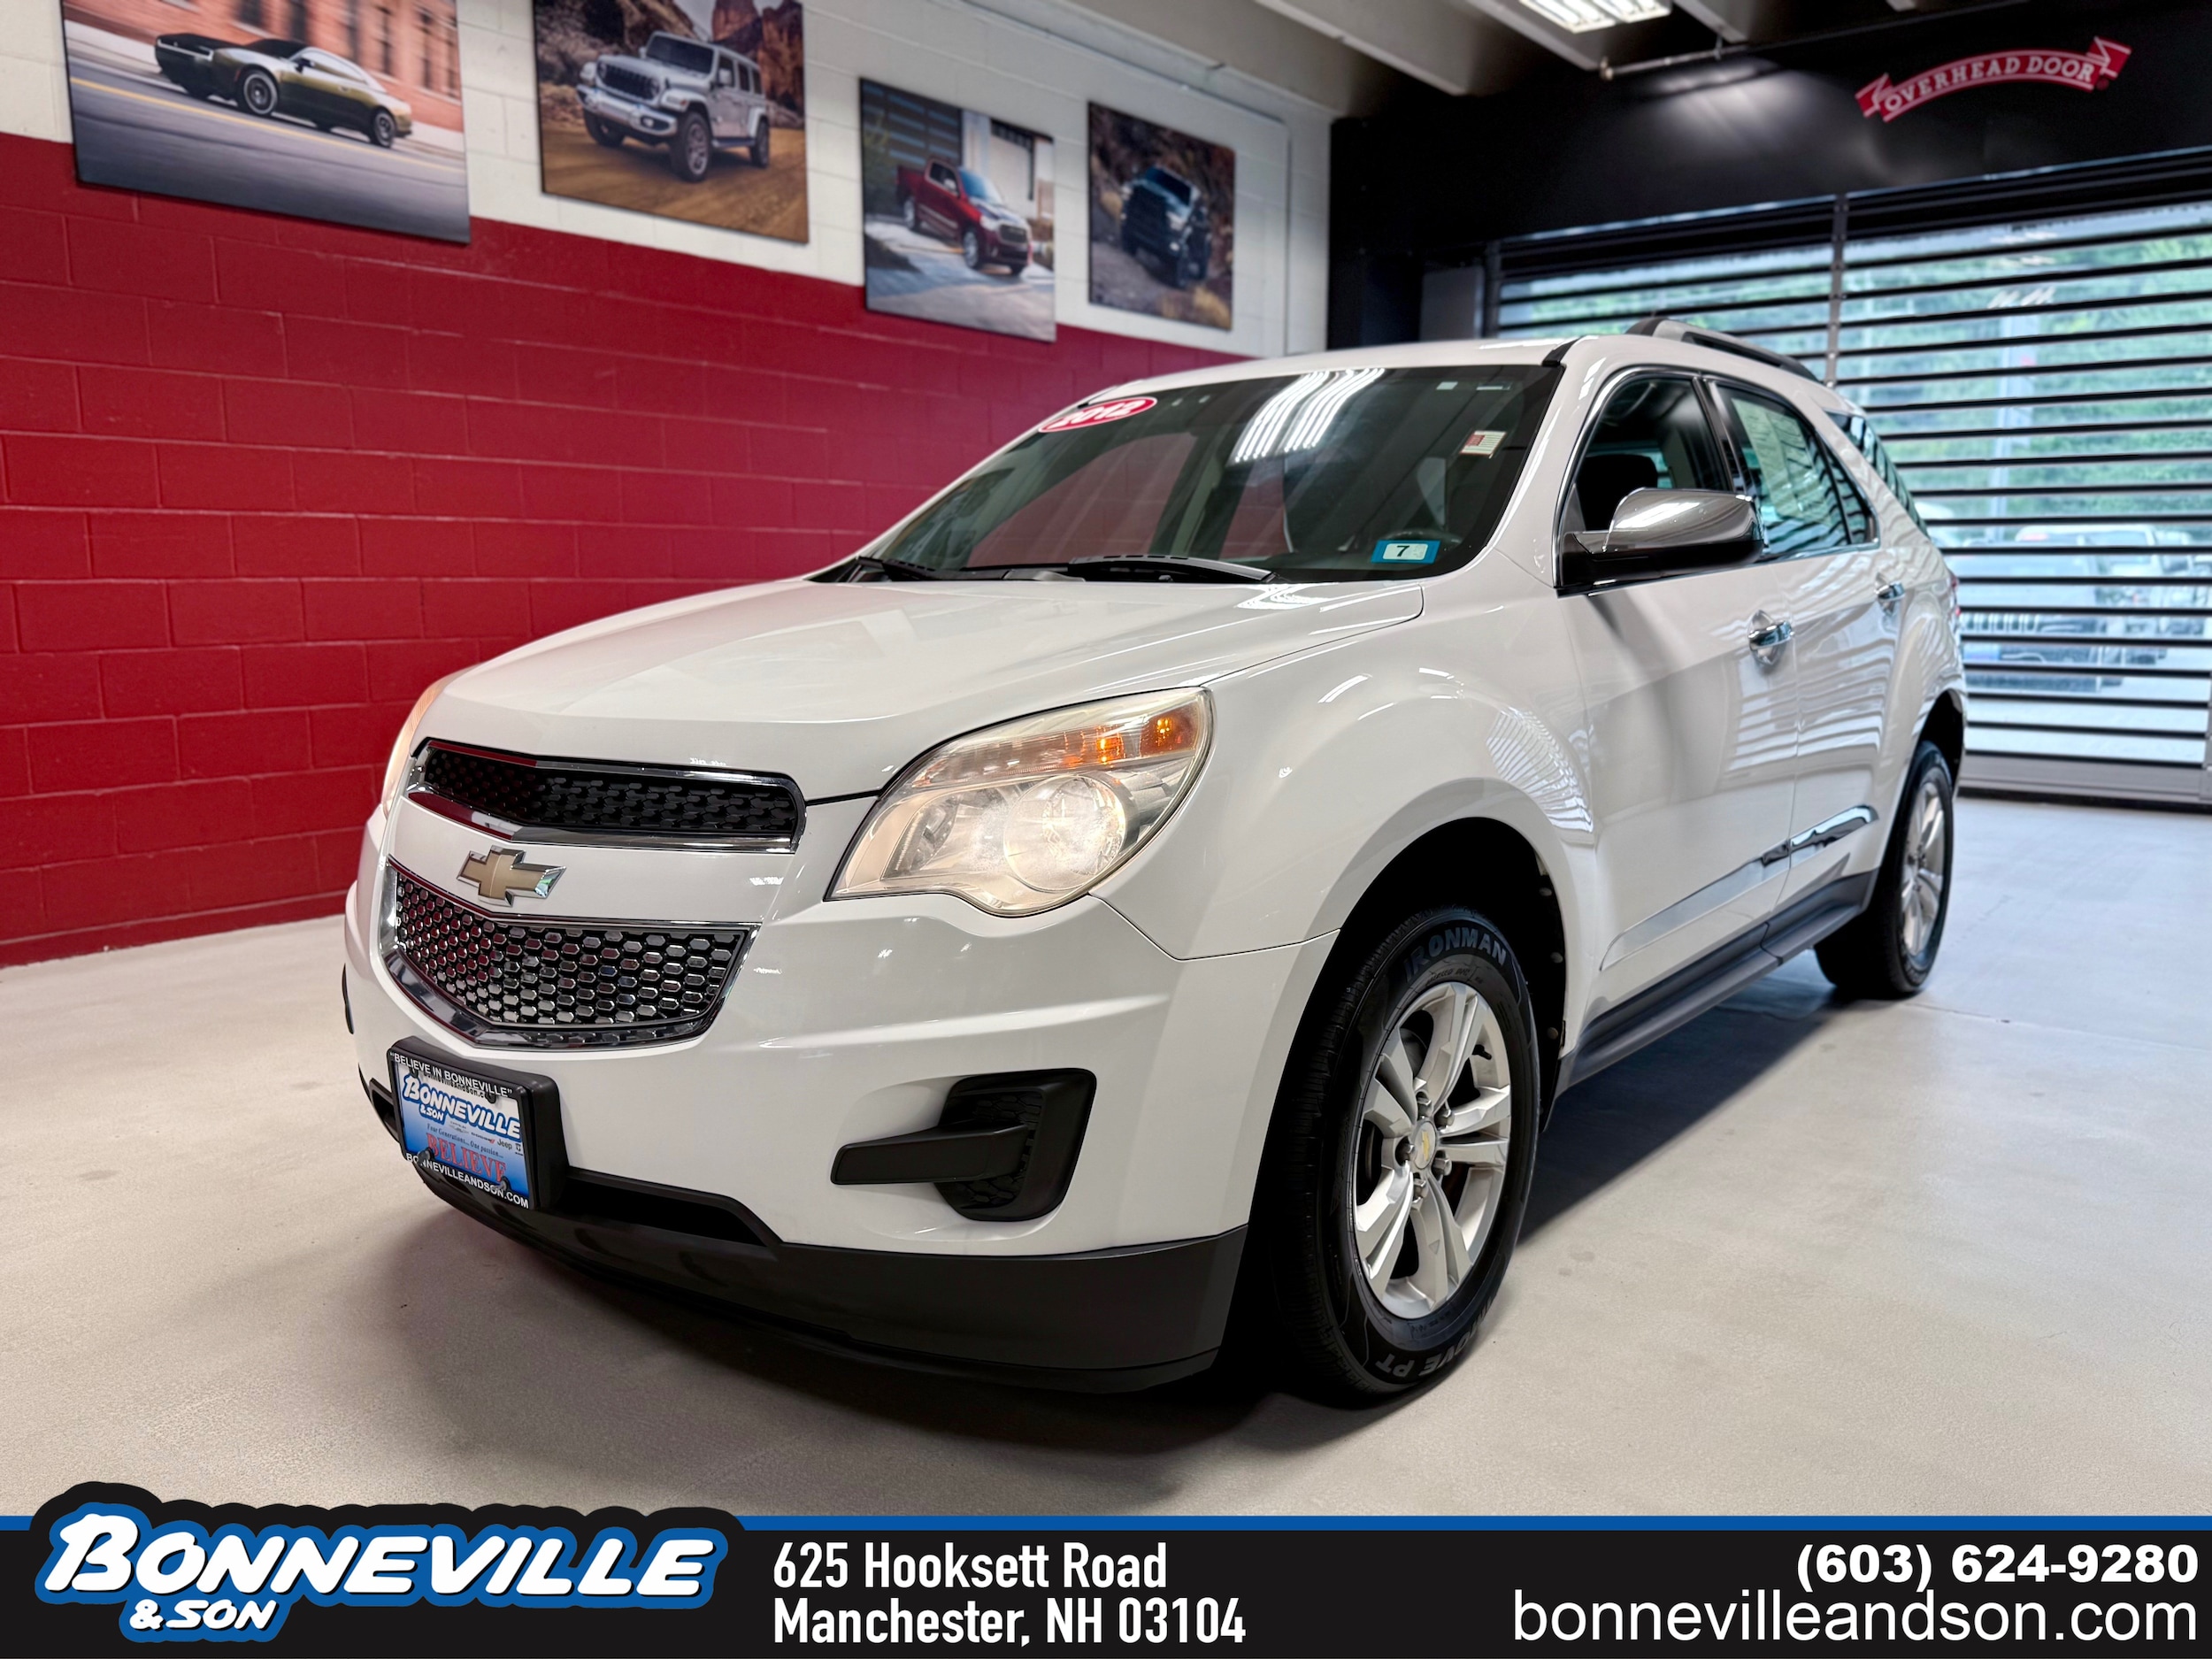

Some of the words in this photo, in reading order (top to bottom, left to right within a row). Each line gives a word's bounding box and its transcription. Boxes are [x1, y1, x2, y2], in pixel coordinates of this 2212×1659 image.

[1885, 57, 2020, 111] OVERHEAD
[2026, 57, 2095, 82] DOOR
[1396, 545, 1410, 557] 7
[1403, 926, 1507, 983] IRONMAN
[432, 1065, 442, 1078] IN
[403, 1076, 521, 1139] BONNEVILLE
[426, 1133, 506, 1183] BELIEVE
[497, 1139, 512, 1150] Jeep
[1375, 1353, 1415, 1378] PT
